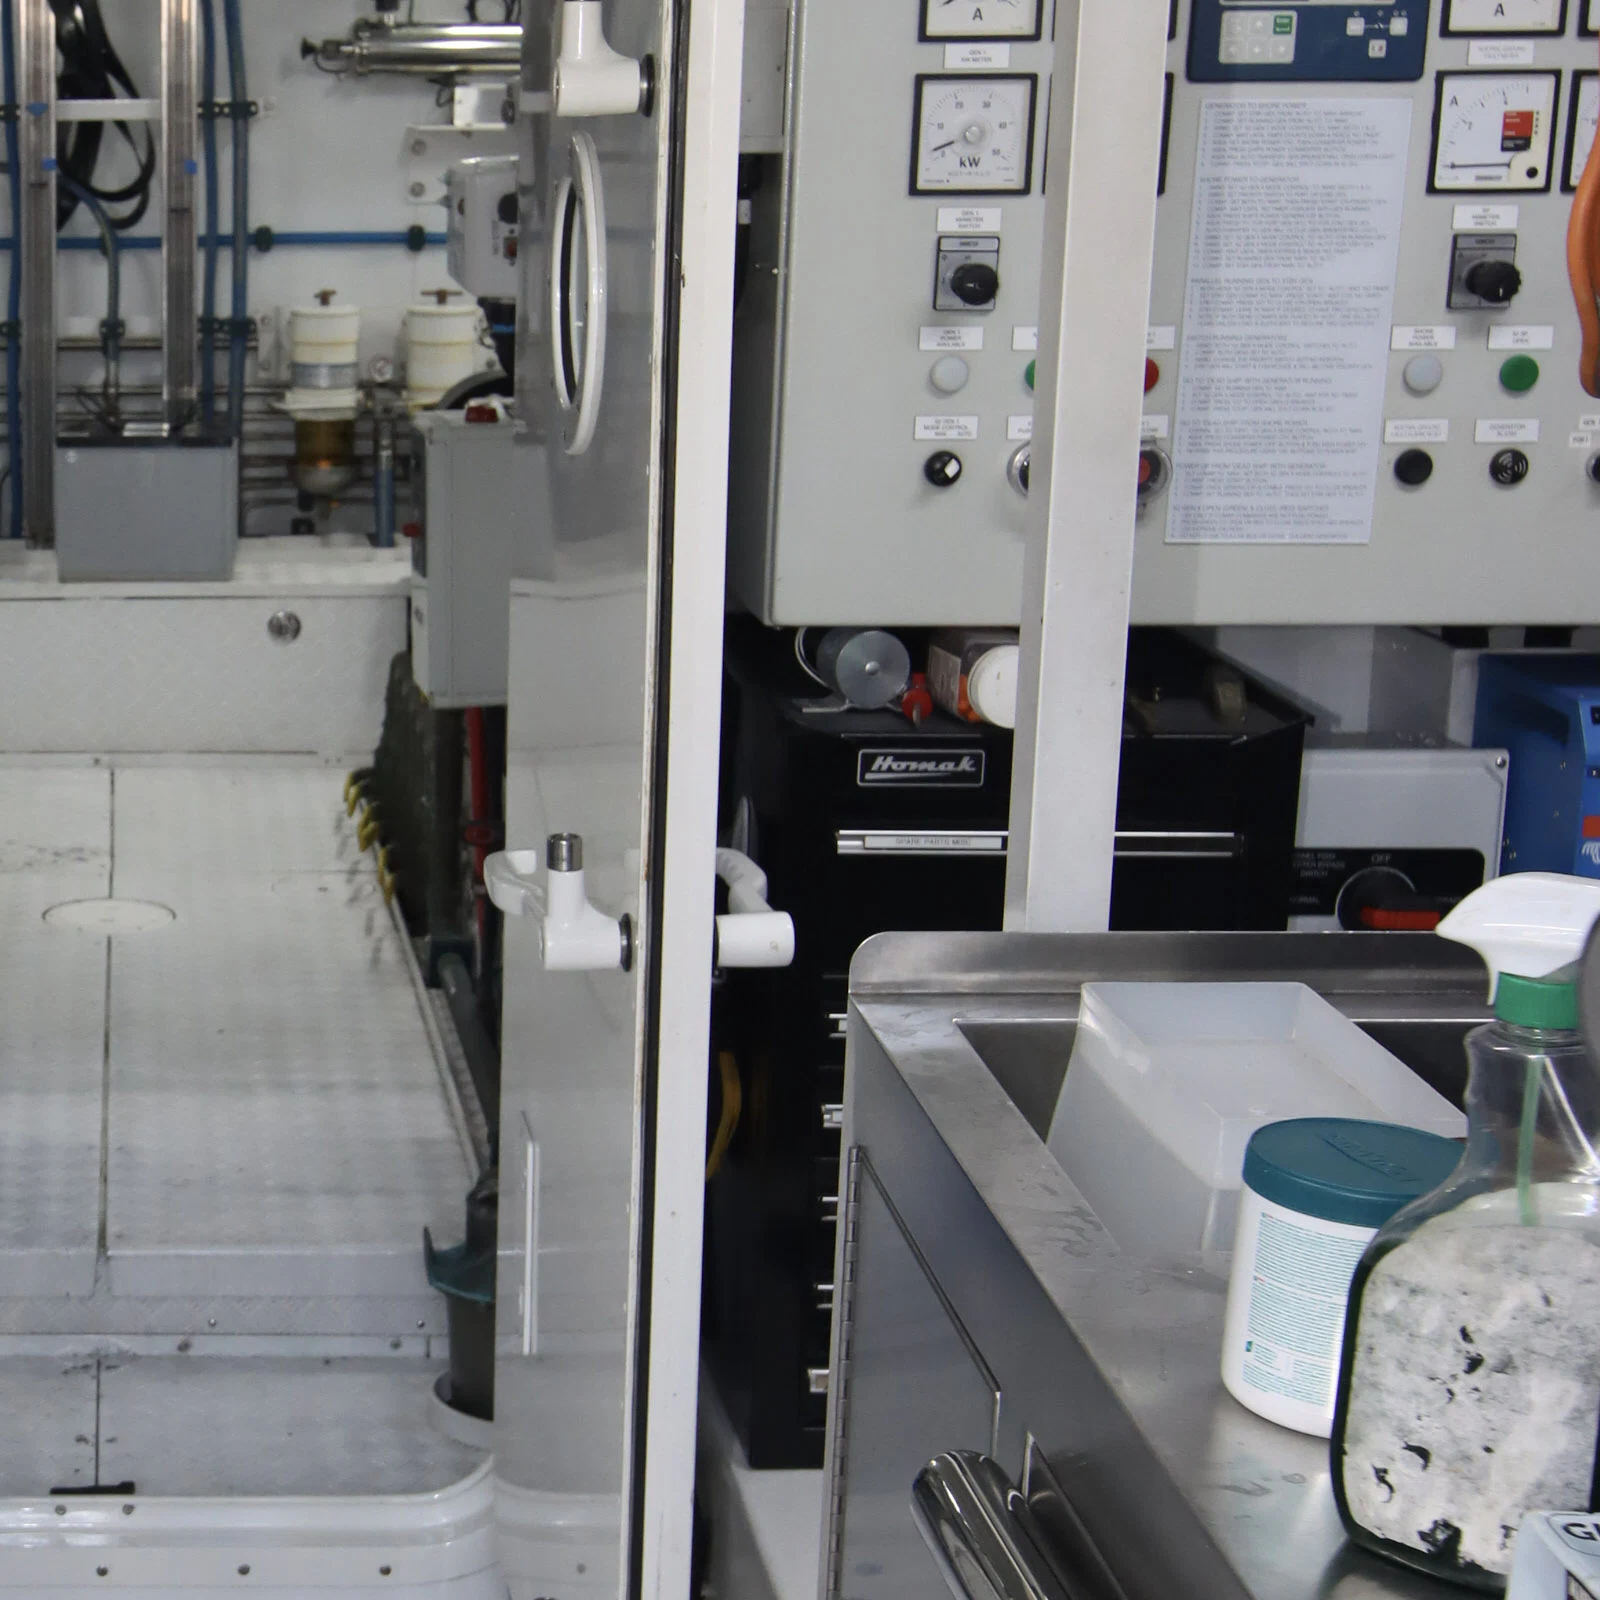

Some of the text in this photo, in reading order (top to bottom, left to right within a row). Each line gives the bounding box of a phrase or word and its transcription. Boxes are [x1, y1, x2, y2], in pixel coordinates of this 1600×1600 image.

[972, 7, 983, 21] A
[1494, 3, 1505, 16] A
[1449, 95, 1459, 107] A
[959, 157, 981, 168] kW
[870, 755, 977, 772] Homak
[1370, 853, 1393, 865] OFF
